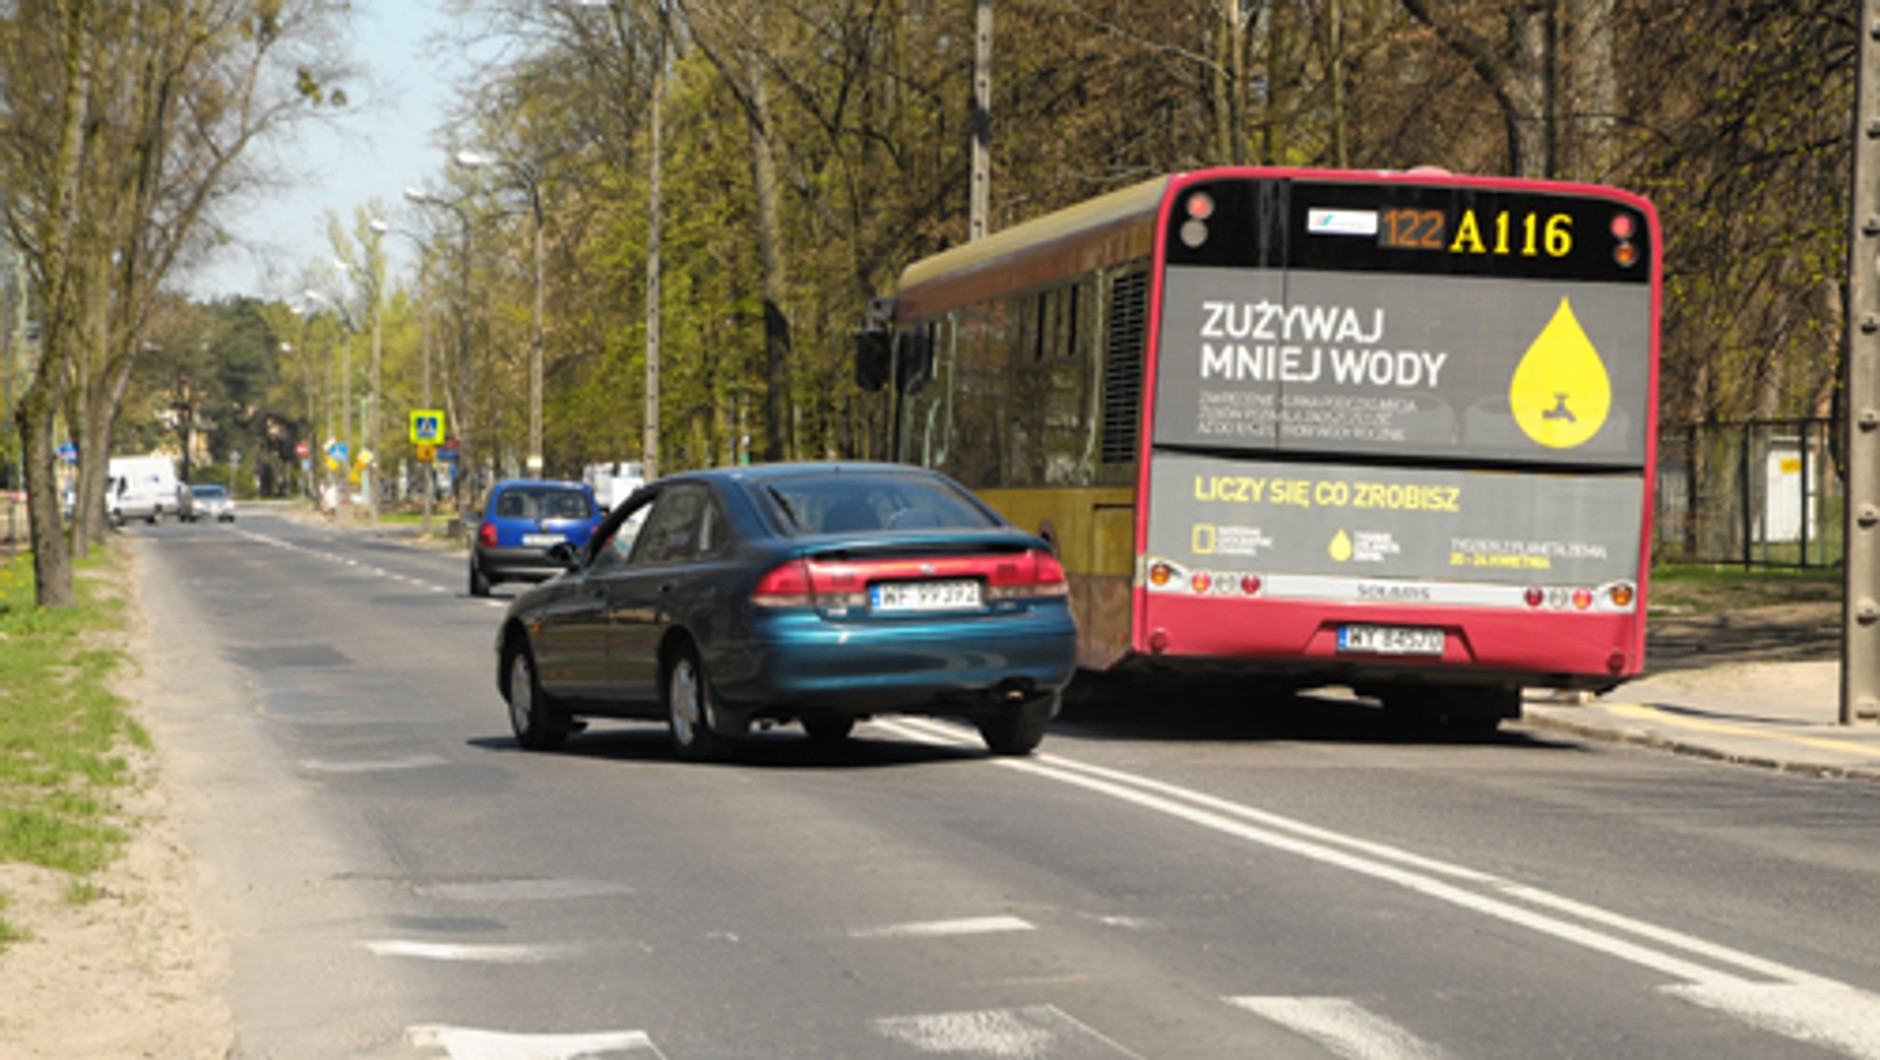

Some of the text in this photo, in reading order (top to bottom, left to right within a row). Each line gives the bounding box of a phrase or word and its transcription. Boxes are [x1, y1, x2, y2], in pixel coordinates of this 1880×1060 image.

[1382, 208, 1445, 248] 122
[1448, 208, 1573, 257] A116
[1200, 299, 1385, 344] ZUŻYWAJ
[1201, 343, 1448, 388] MNIEJ WODY
[1194, 476, 1461, 512] LICZY SIĘ CO ZROBISZ
